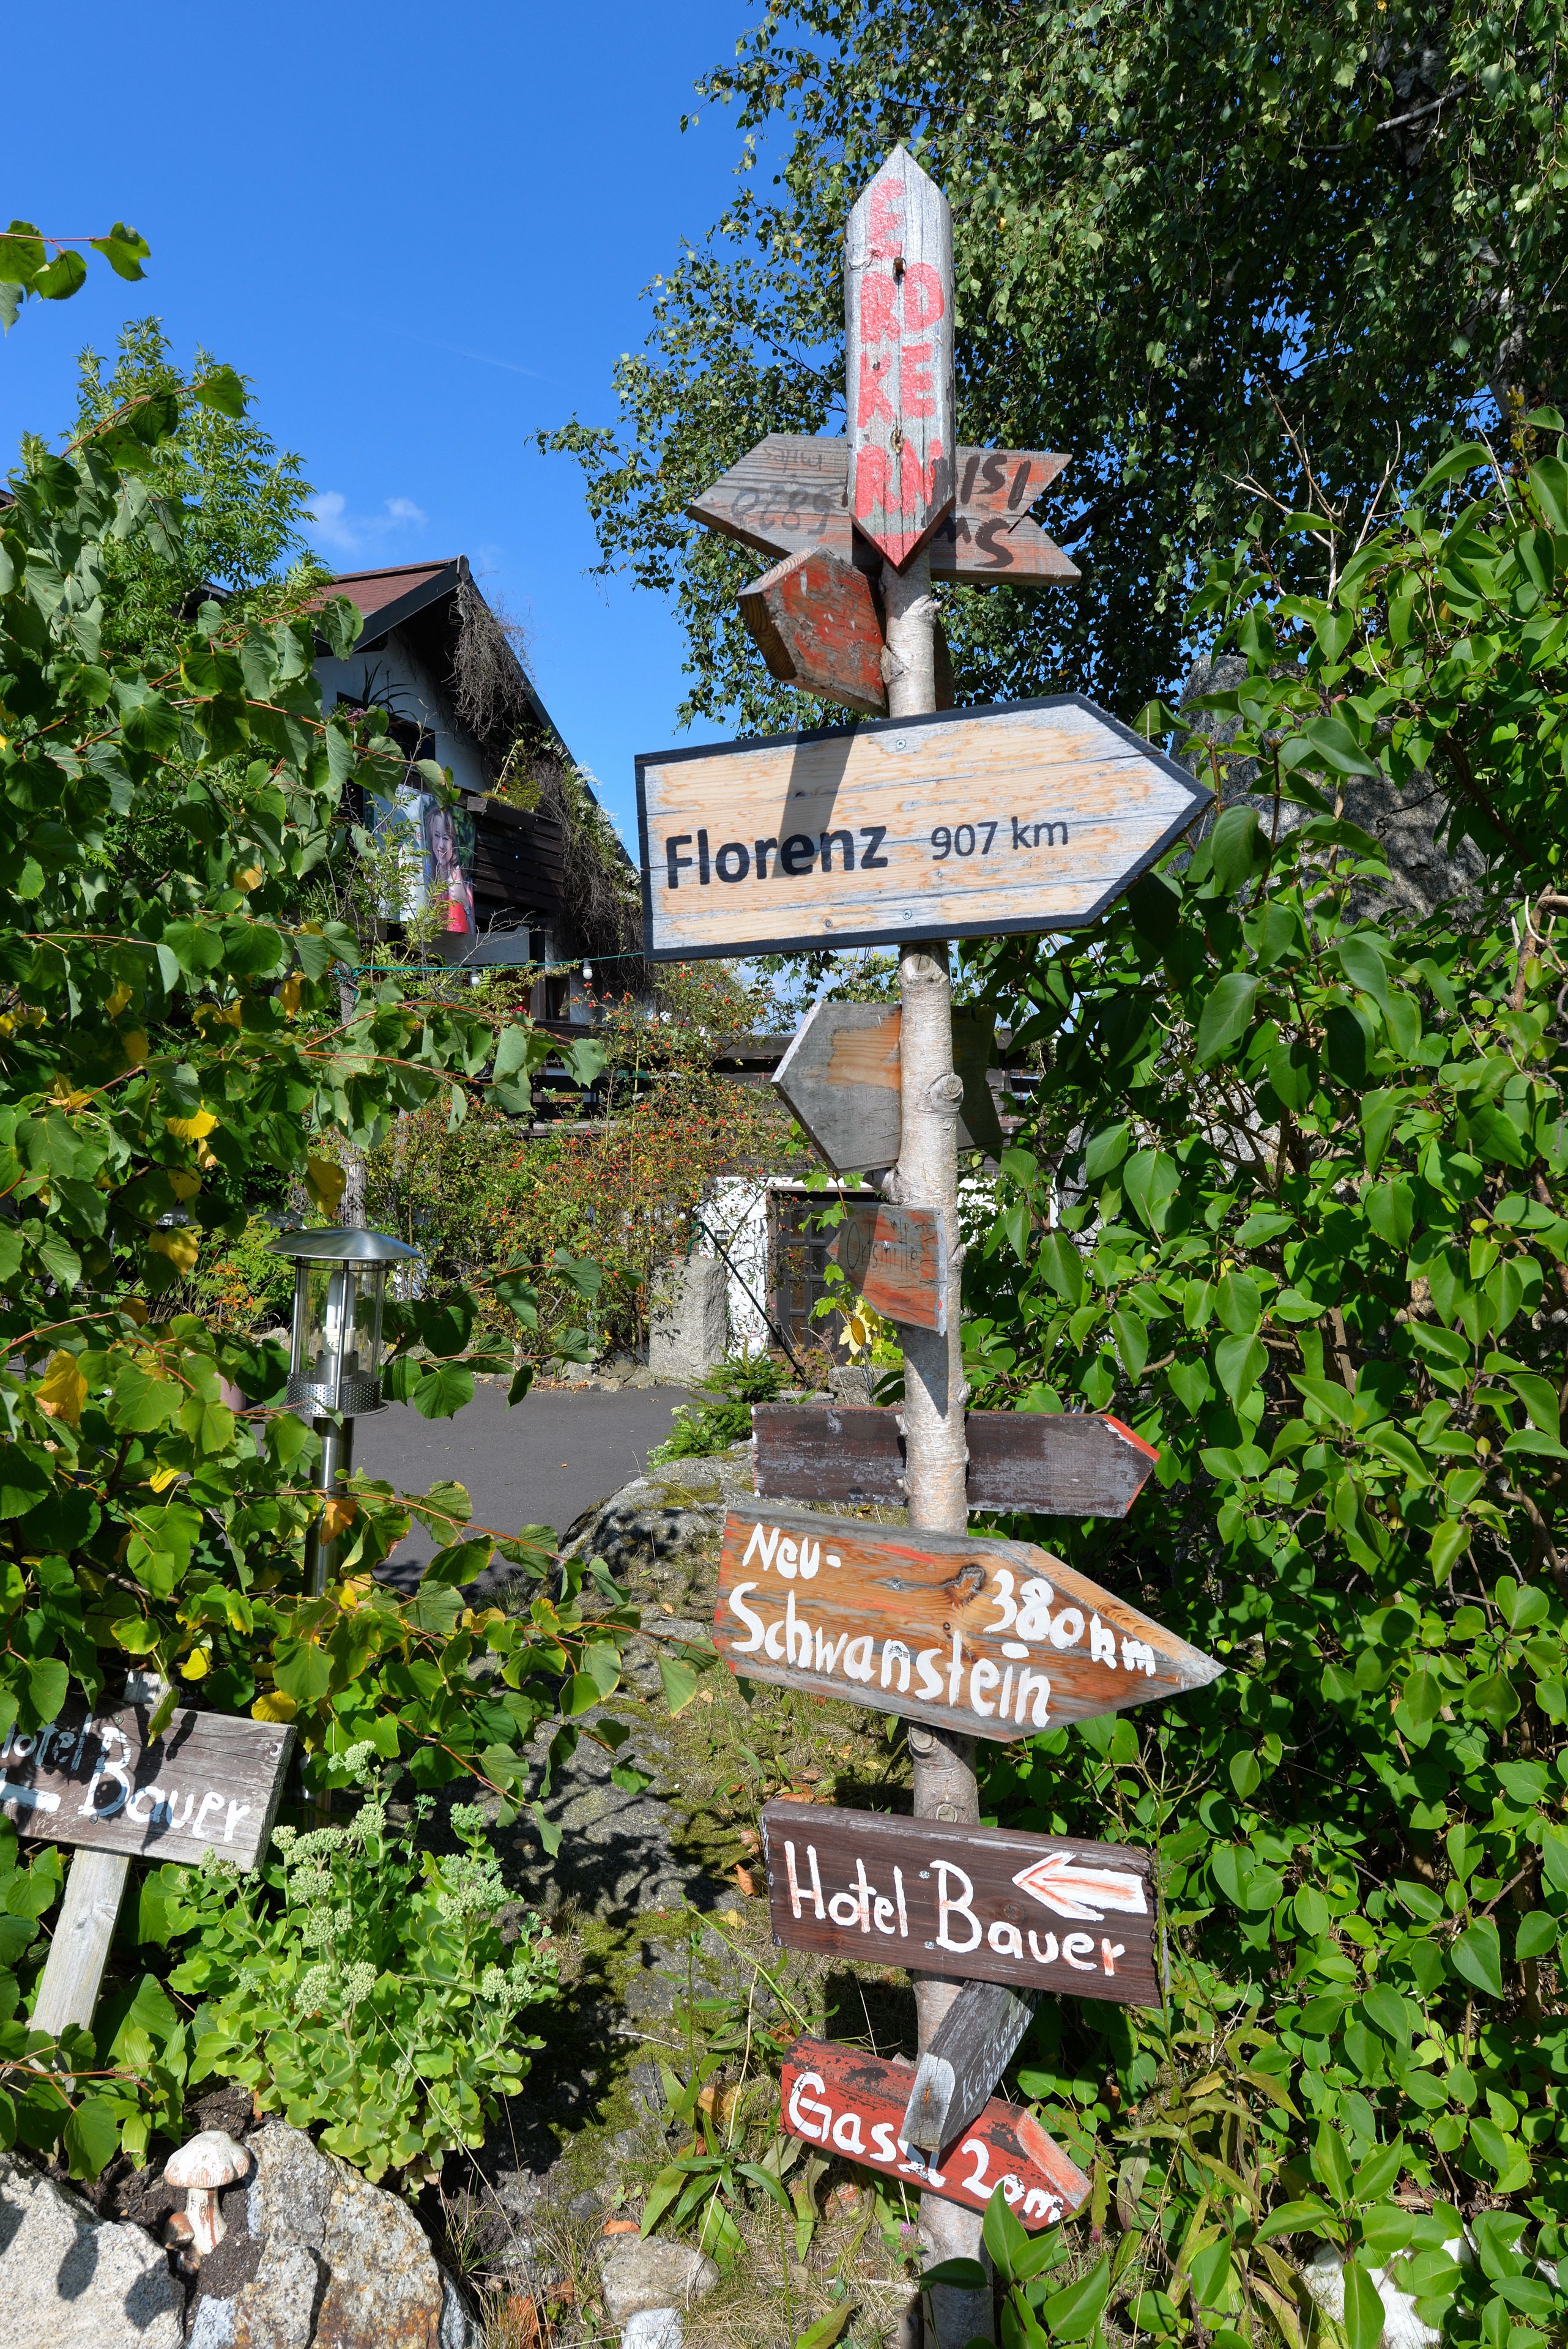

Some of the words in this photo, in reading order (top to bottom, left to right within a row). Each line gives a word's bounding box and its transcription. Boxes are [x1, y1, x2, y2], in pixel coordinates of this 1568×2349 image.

[665, 825, 888, 889] Florenz
[931, 820, 998, 860] 907
[1011, 817, 1069, 850] km
[742, 1522, 842, 1579] Neu-
[729, 1581, 1050, 1727] Schwanstein
[78, 1726, 250, 1842] Bauer
[784, 1841, 908, 1938] Hotel
[930, 1860, 1126, 1976] Bauer
